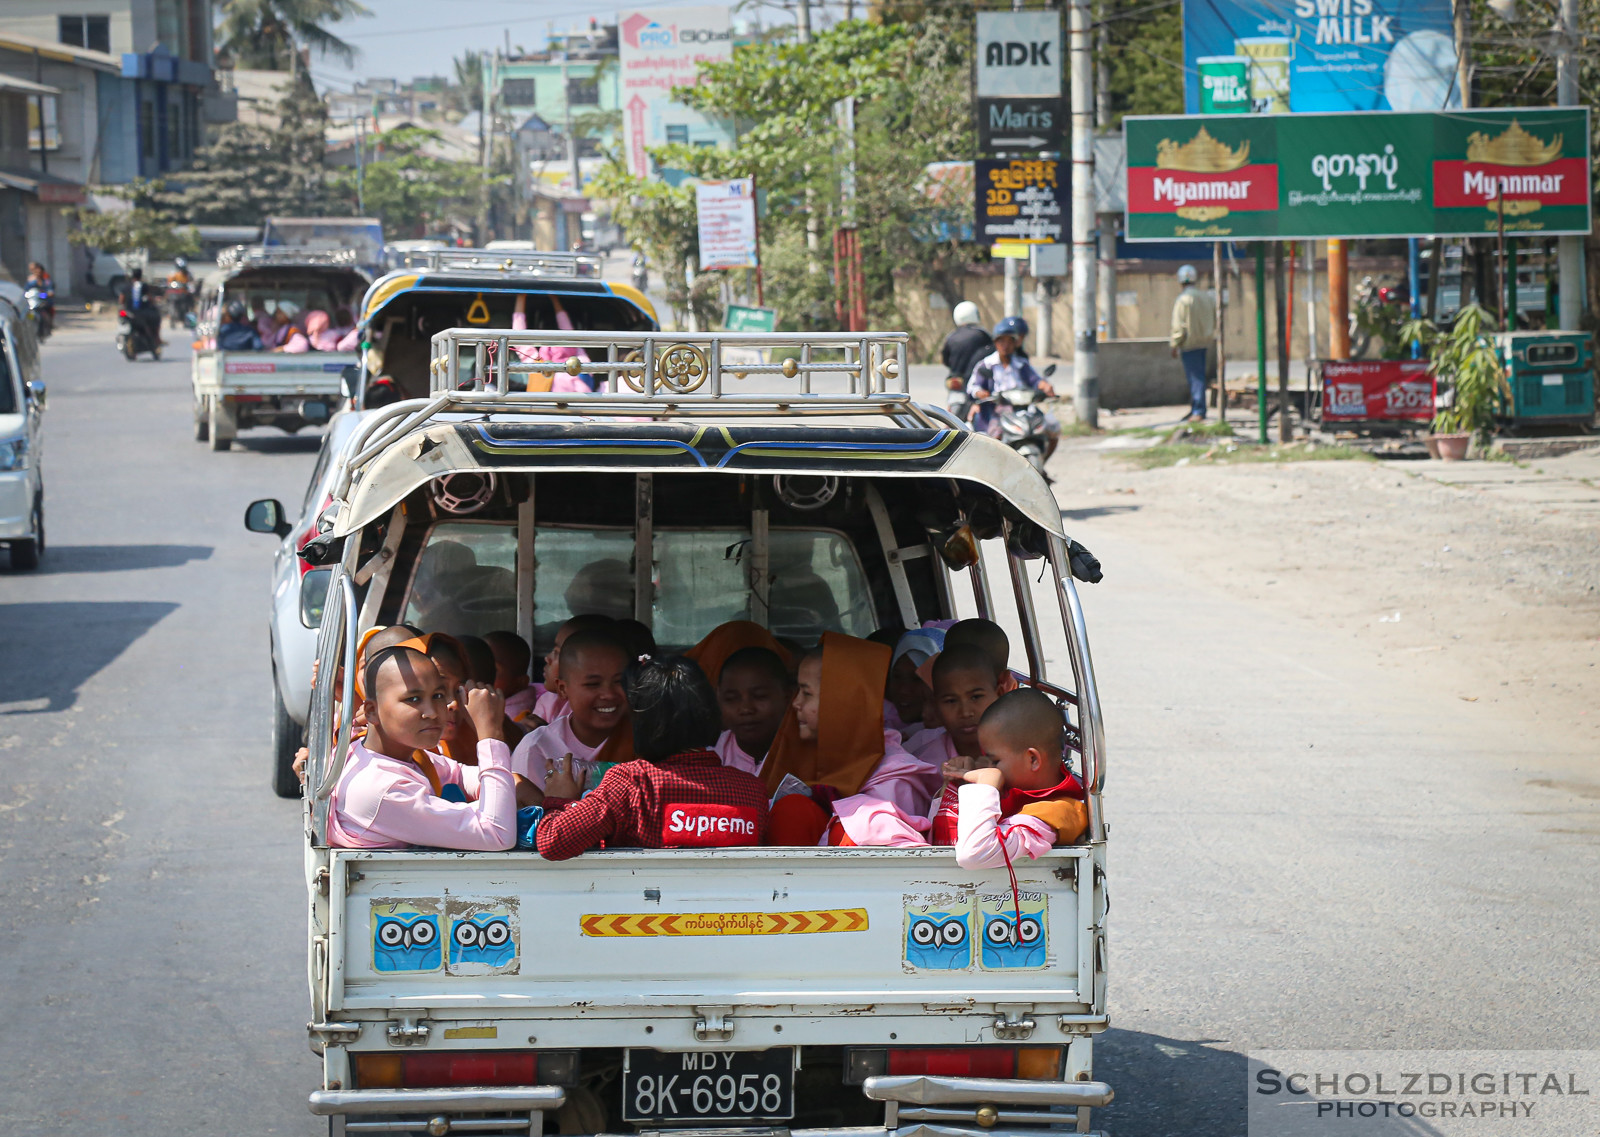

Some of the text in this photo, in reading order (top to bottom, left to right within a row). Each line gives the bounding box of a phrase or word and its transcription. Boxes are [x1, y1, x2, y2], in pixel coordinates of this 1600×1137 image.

[1315, 15, 1394, 44] MILK
[986, 41, 1051, 67] ADK
[1203, 75, 1239, 89] SWIS
[1211, 86, 1248, 101] MILK
[1312, 144, 1398, 190] ရတနာပုံ
[986, 189, 1011, 204] 3D
[1153, 178, 1251, 206] Myanmar
[1464, 171, 1564, 199] Myanmar
[1385, 390, 1433, 407] 120%
[669, 809, 755, 837] Supreme
[682, 1052, 735, 1070] MDY
[635, 1074, 781, 1114] 8K-6958
